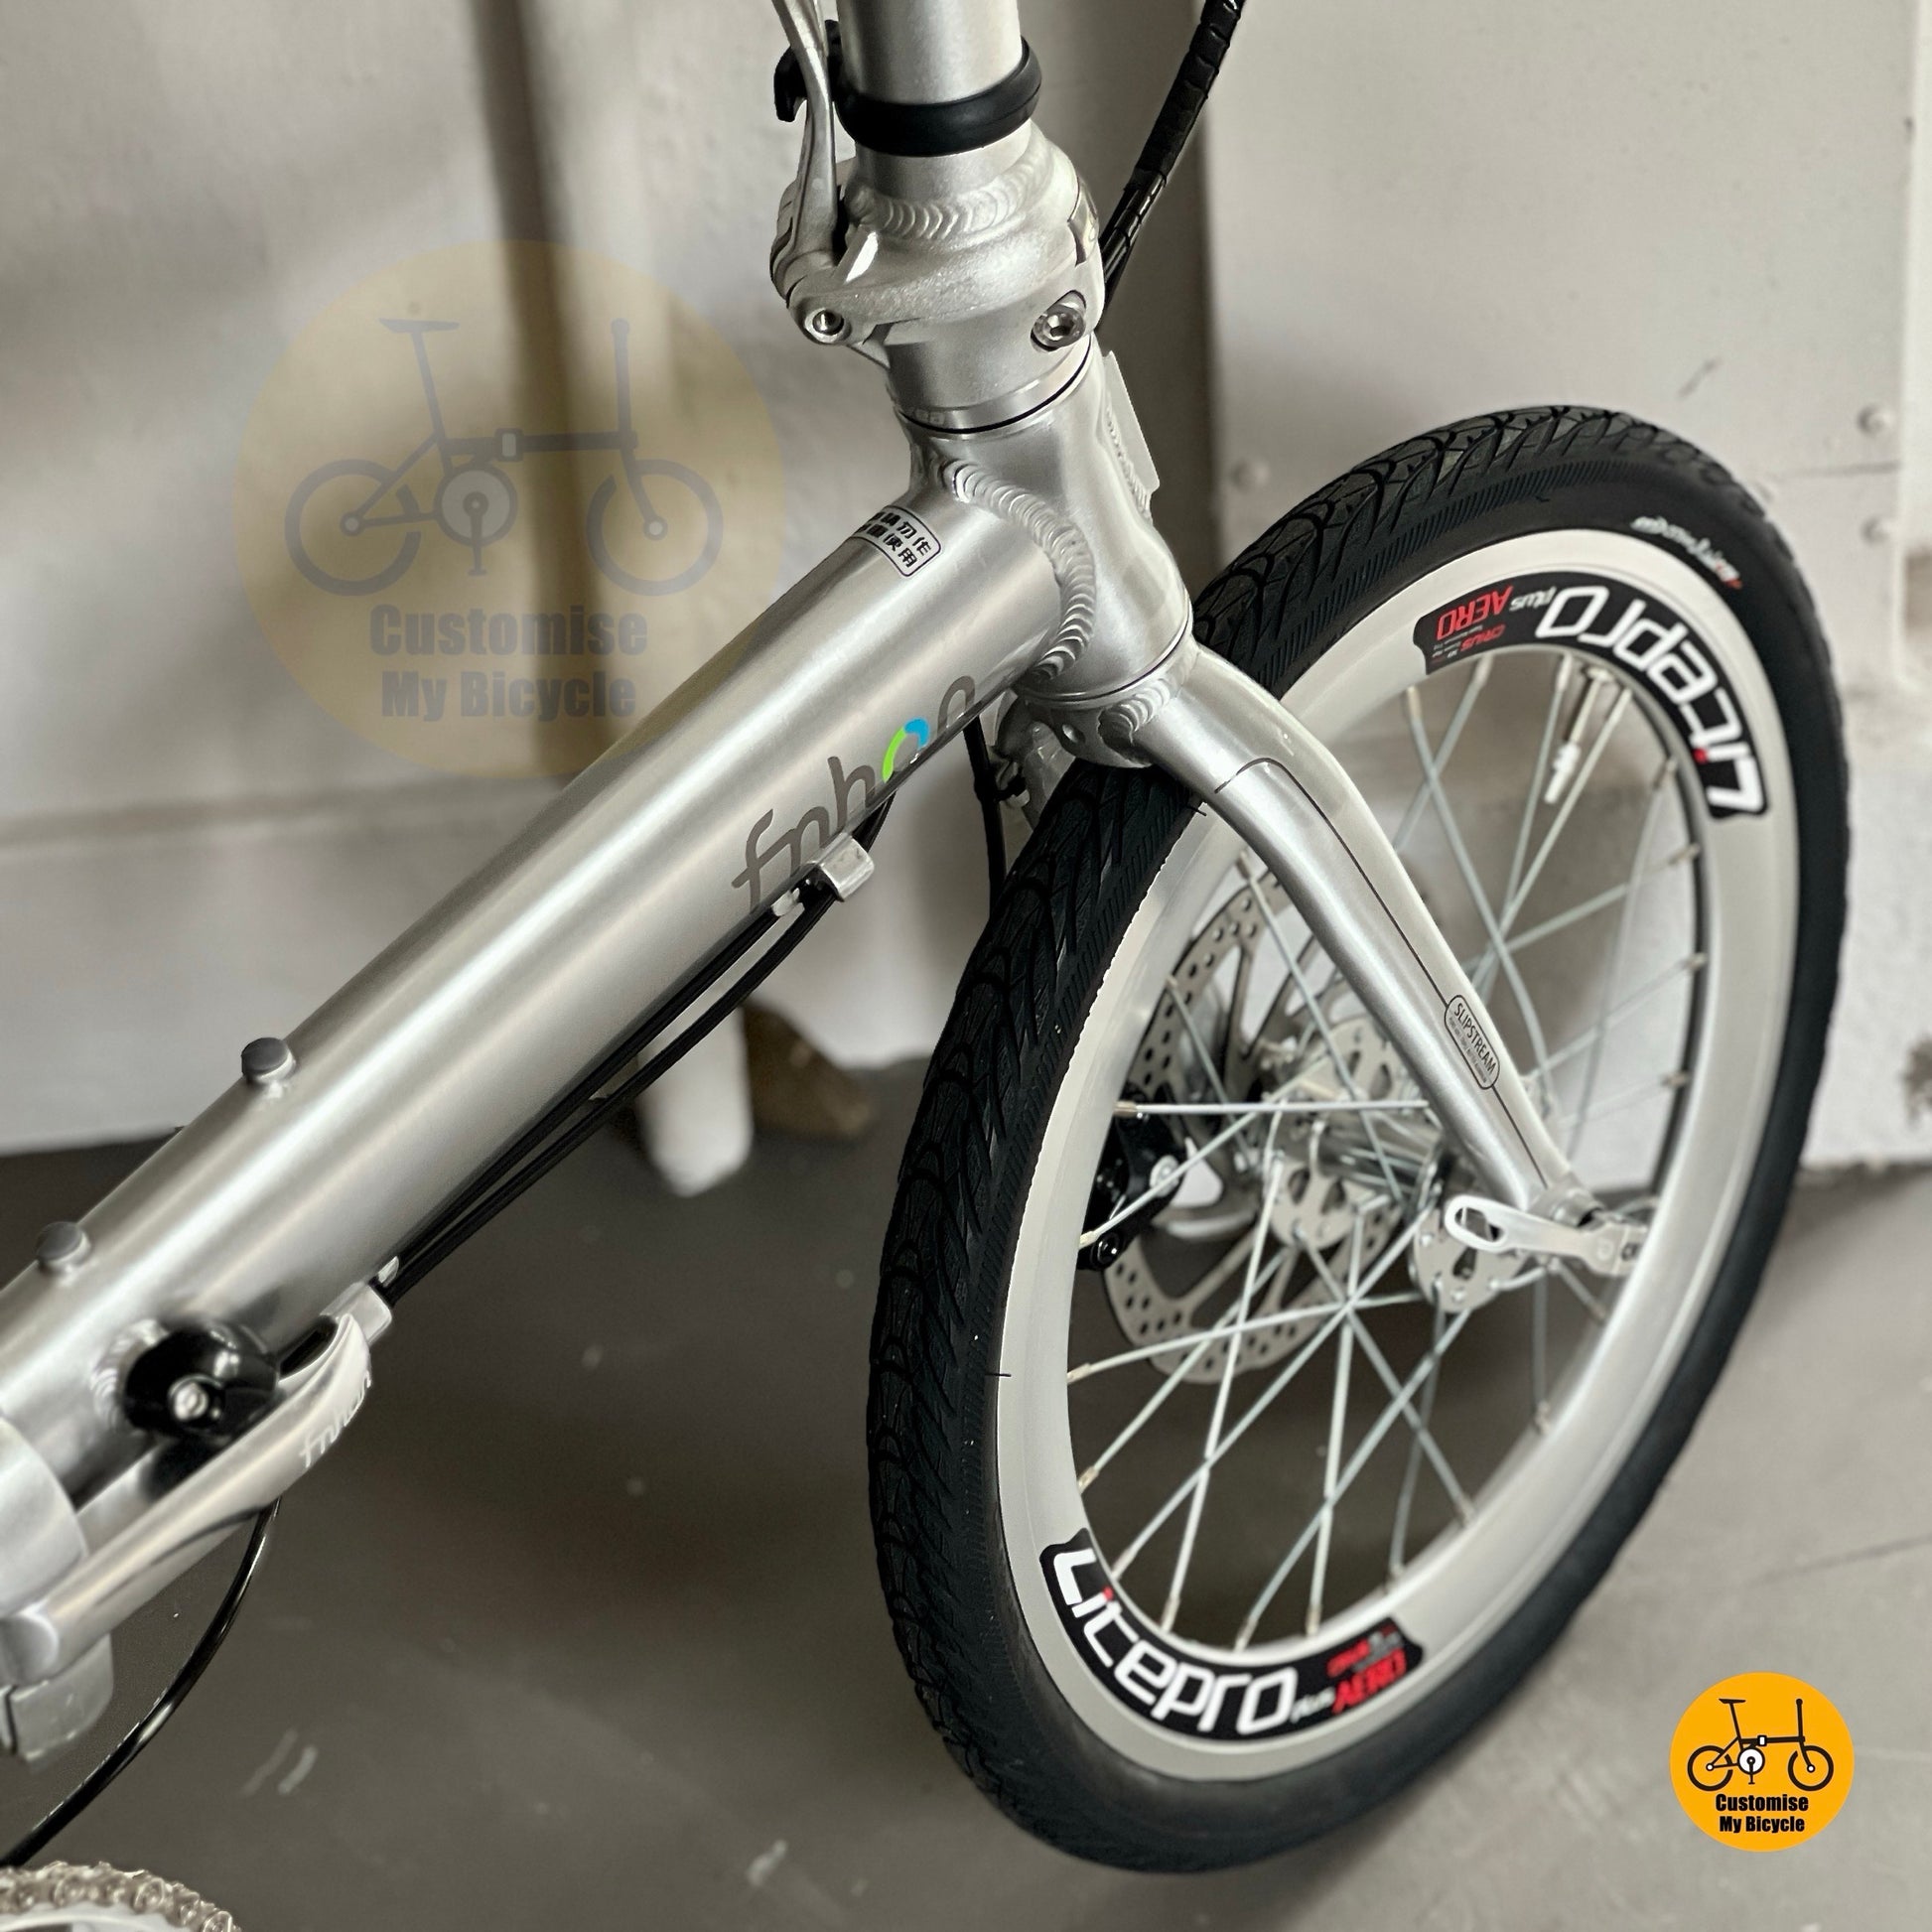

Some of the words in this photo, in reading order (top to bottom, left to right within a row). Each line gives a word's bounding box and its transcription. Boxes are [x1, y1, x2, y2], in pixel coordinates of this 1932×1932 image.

[1436, 584, 1513, 640] AERO
[1535, 584, 1766, 814] Litepro
[1453, 1002, 1498, 1075] SLIPSTREAM
[1052, 1548, 1299, 1736] Litepro
